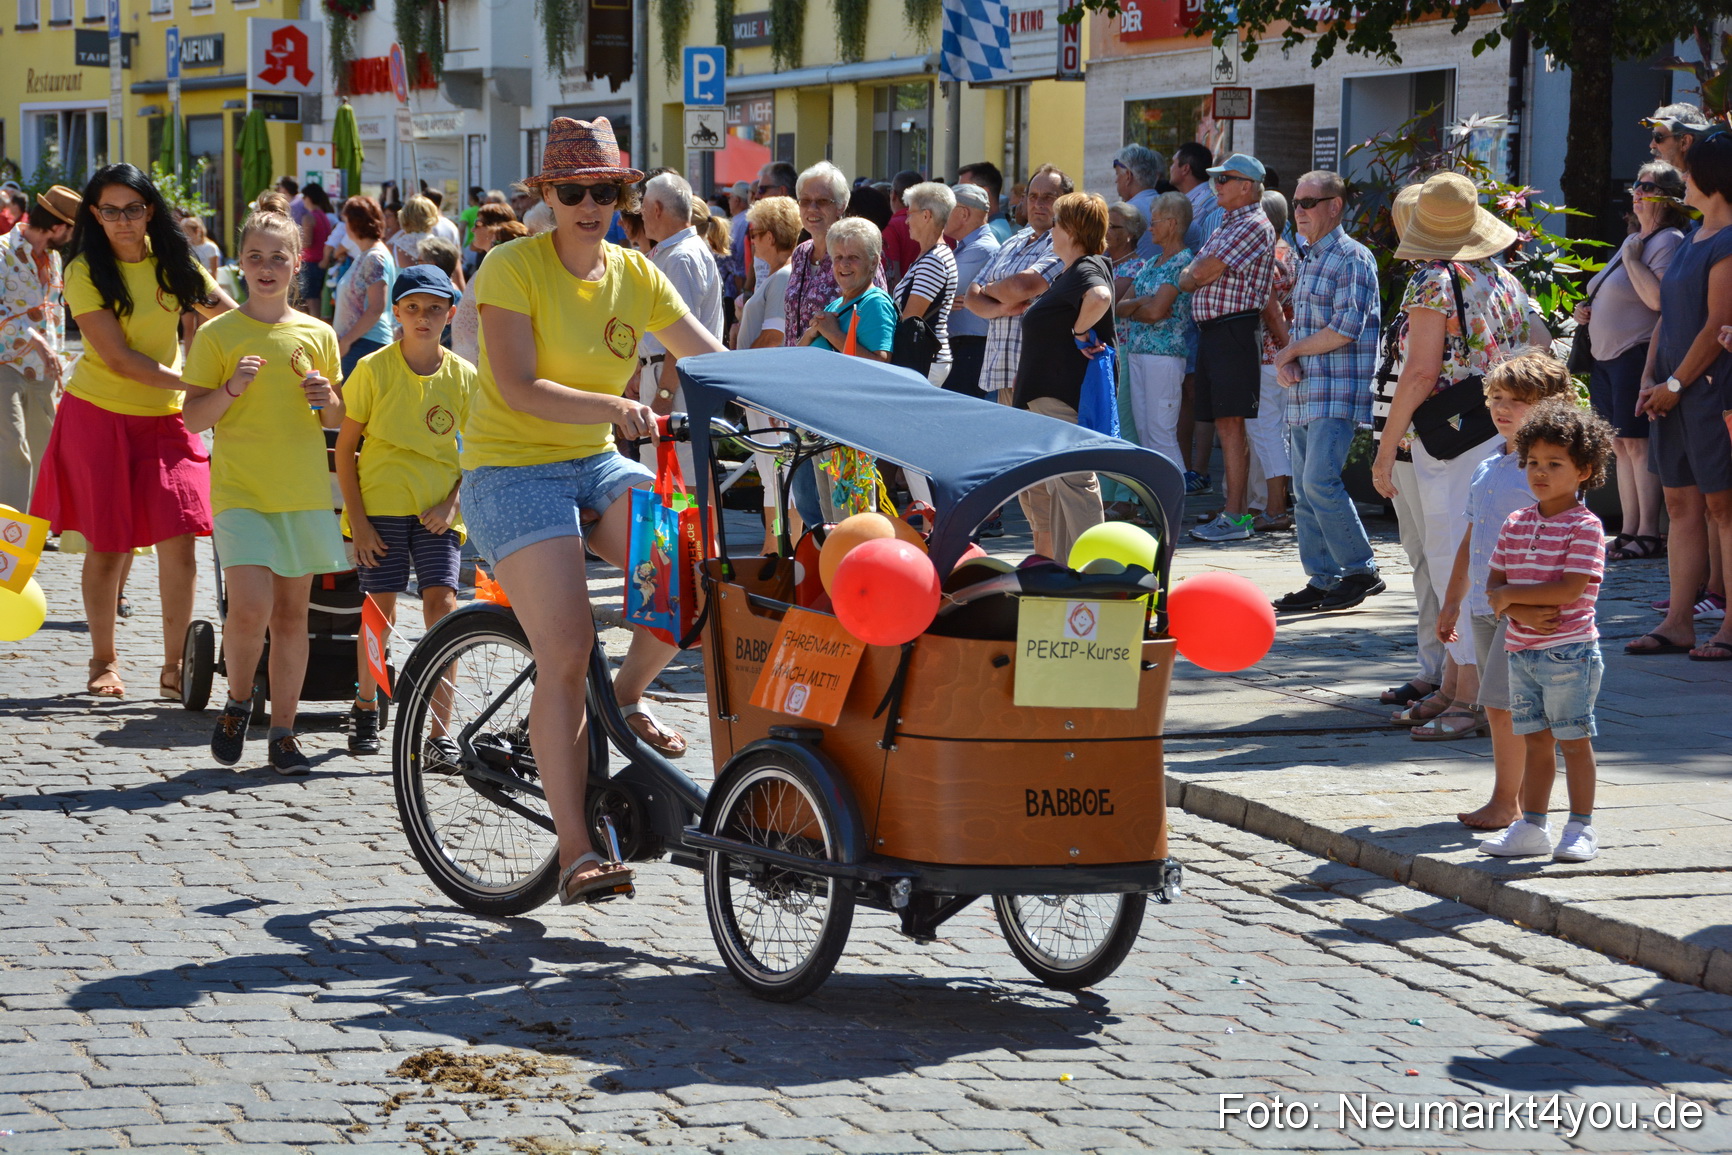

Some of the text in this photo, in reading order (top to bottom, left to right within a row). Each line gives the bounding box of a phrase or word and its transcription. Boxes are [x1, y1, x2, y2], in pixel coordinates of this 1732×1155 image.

[733, 22, 757, 39] WOLLE
[1020, 9, 1044, 32] KINO
[1121, 9, 1142, 32] DER
[79, 52, 128, 64] TAIFN
[167, 34, 177, 73] P
[180, 38, 214, 62] AIFUN
[26, 67, 82, 93] Restaurant
[693, 54, 716, 98] P
[697, 113, 711, 121] nur
[782, 630, 851, 658] EHRENAMT-
[1027, 639, 1130, 660] PEKIP-Kurse
[772, 662, 840, 691] MACH MIT!!
[1025, 787, 1115, 817] BABBOE
